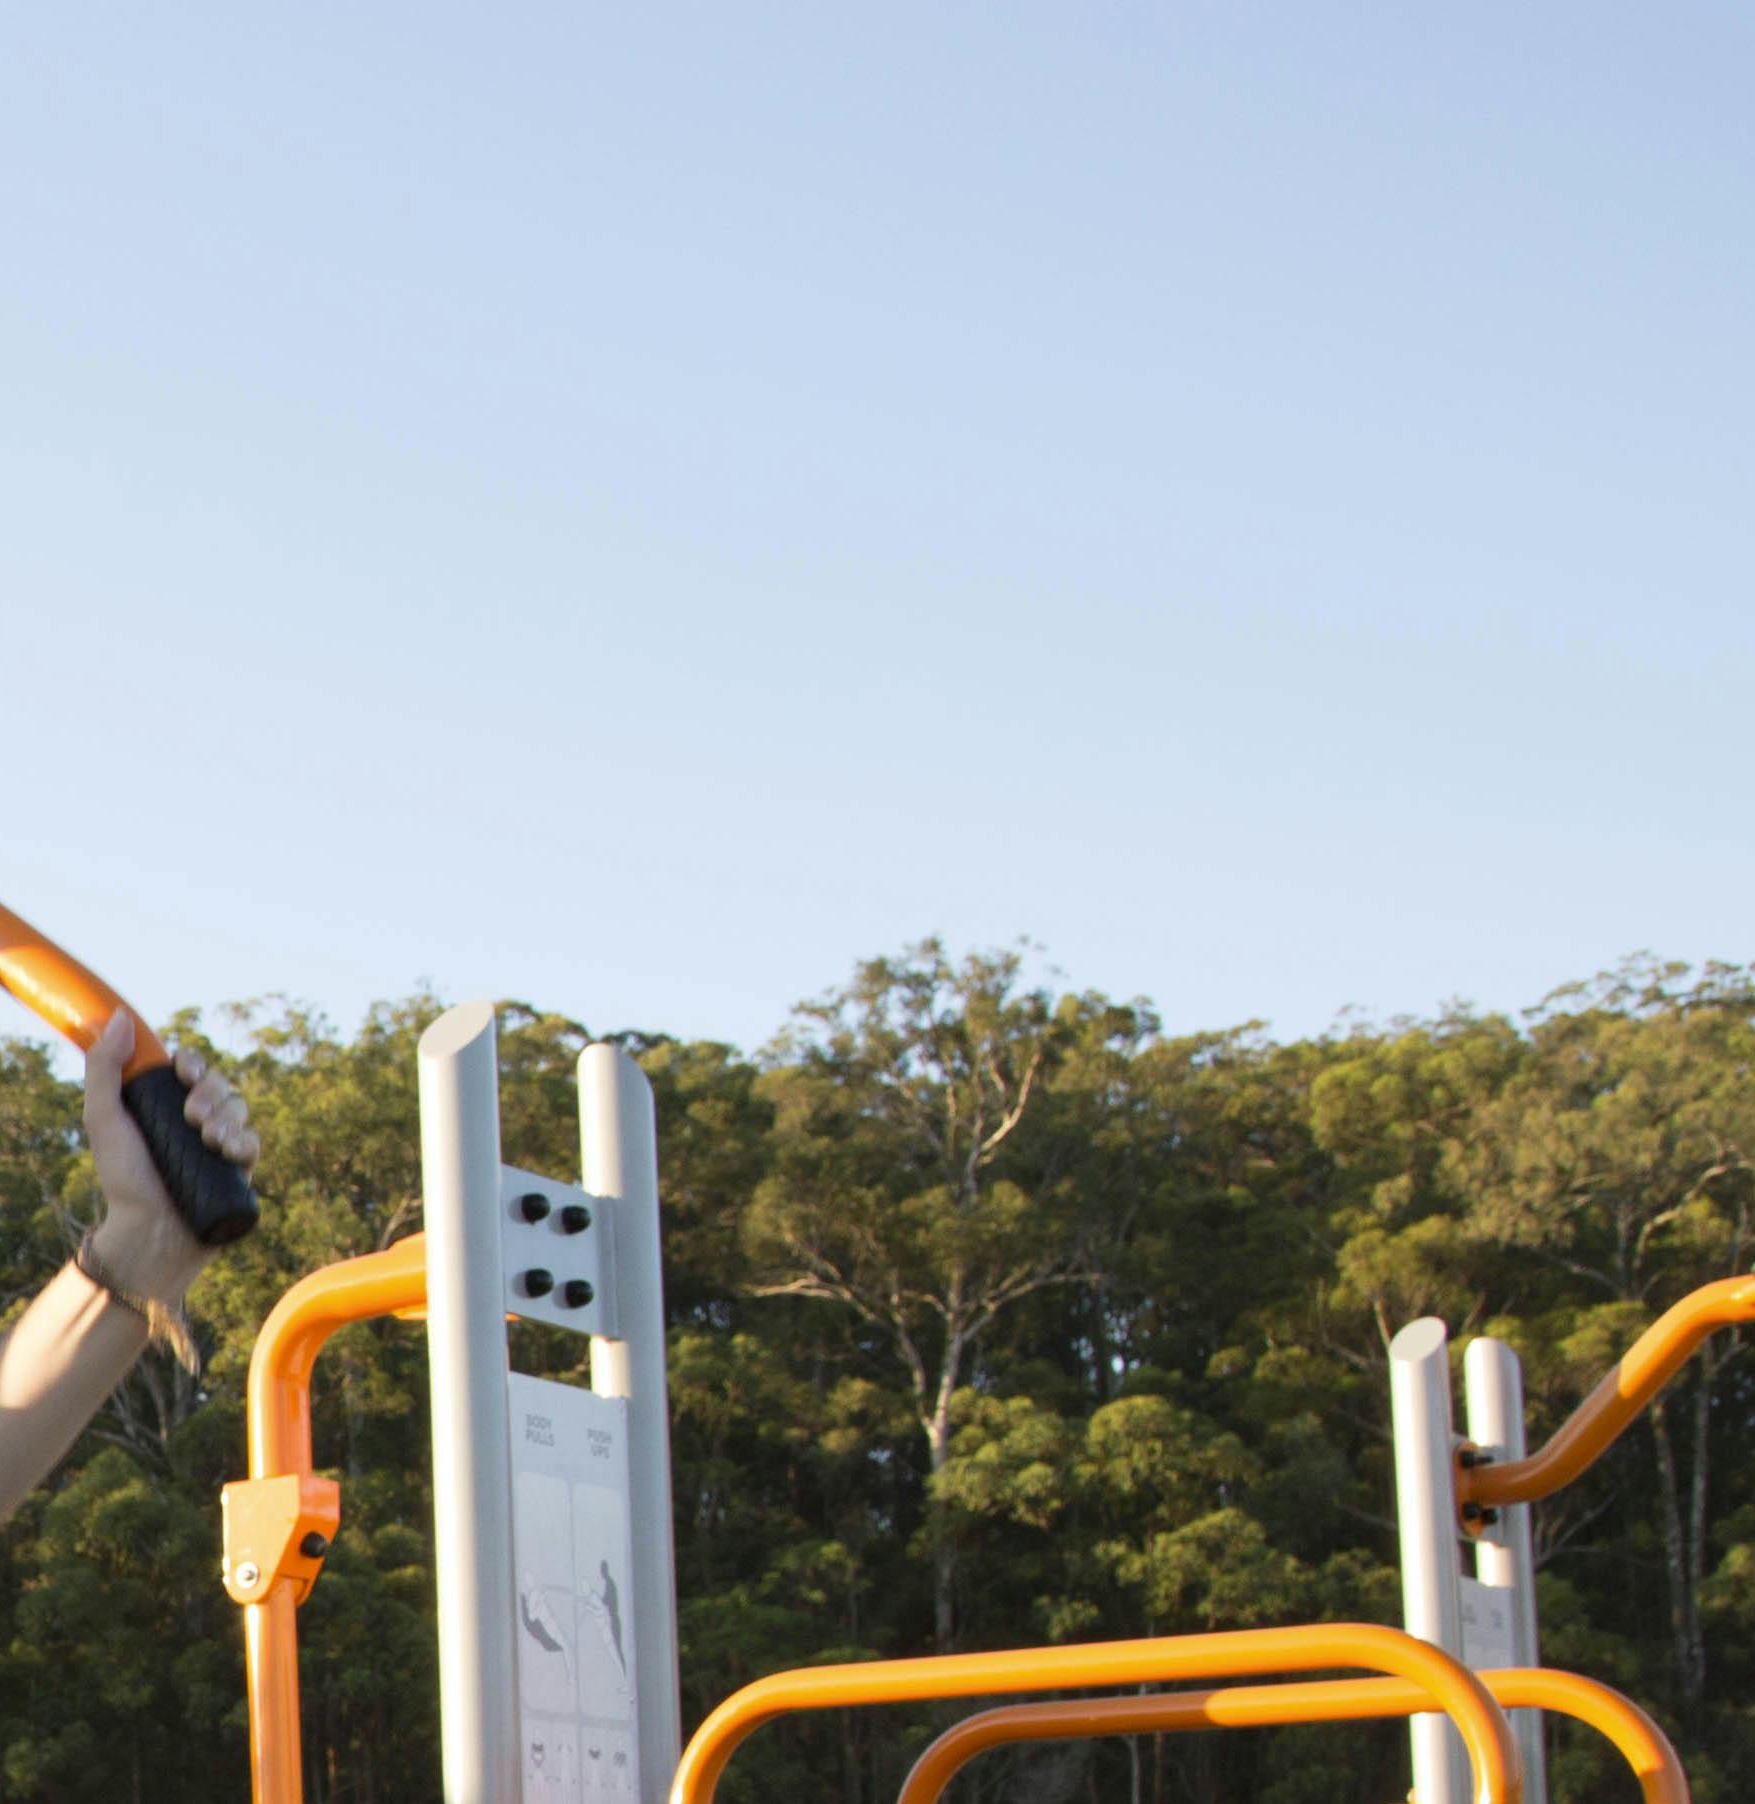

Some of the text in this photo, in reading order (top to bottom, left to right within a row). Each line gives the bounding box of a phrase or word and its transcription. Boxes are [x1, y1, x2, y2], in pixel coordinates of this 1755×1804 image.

[525, 1413, 553, 1430] BODY
[525, 1429, 555, 1447] PULLS
[587, 1427, 612, 1444] PUSH
